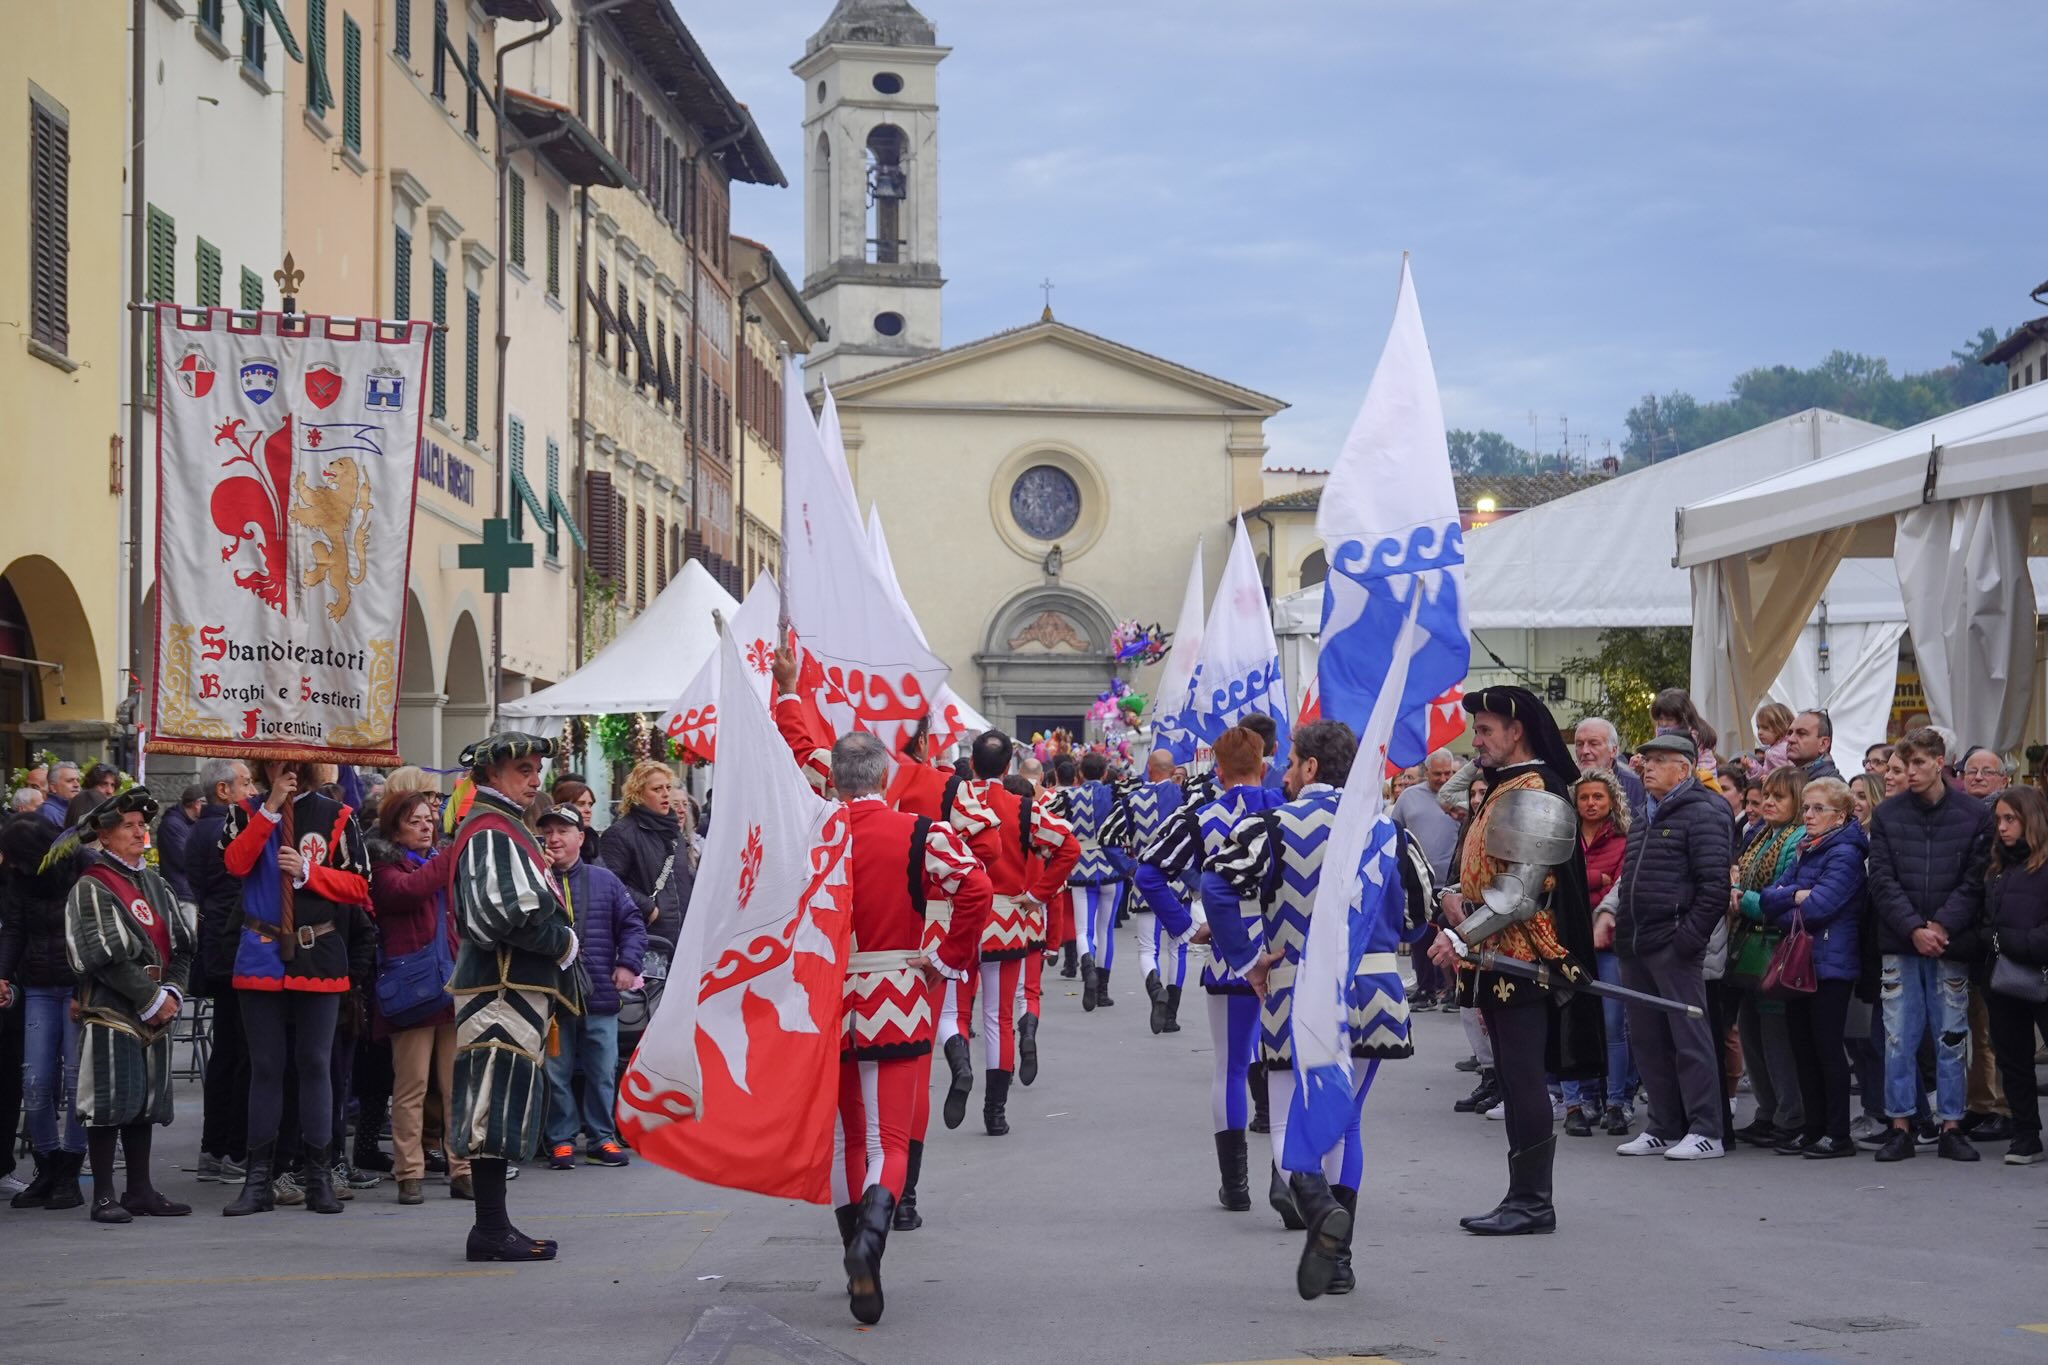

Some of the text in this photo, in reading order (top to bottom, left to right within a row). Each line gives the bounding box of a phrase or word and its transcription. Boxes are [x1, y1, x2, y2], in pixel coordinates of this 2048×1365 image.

[199, 673, 361, 710] Borghi e Sestieri
[241, 707, 322, 738] Fiorentini
